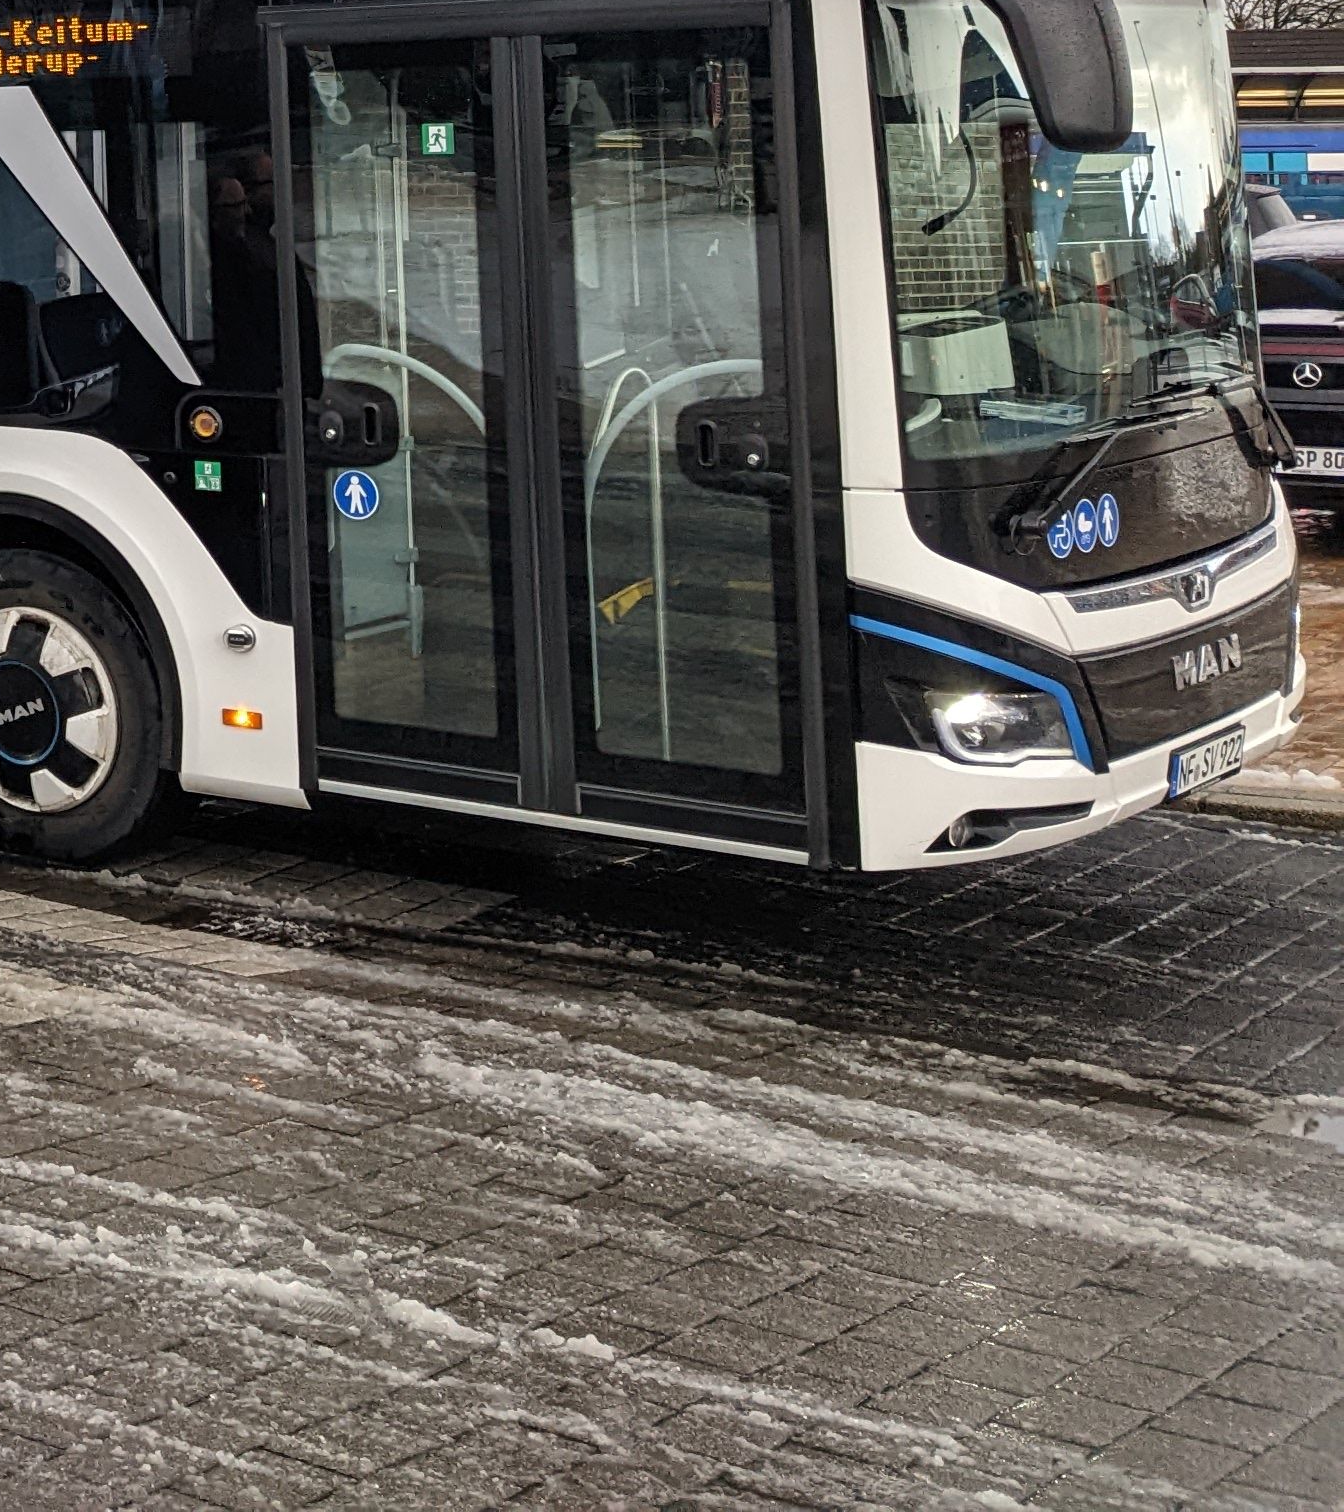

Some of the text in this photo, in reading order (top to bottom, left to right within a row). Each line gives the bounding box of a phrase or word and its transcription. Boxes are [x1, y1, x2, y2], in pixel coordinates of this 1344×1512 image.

[1170, 632, 1243, 691] MAN
[1178, 753, 1196, 788] NF
[1201, 742, 1220, 778] SV
[1219, 733, 1243, 771] 922
